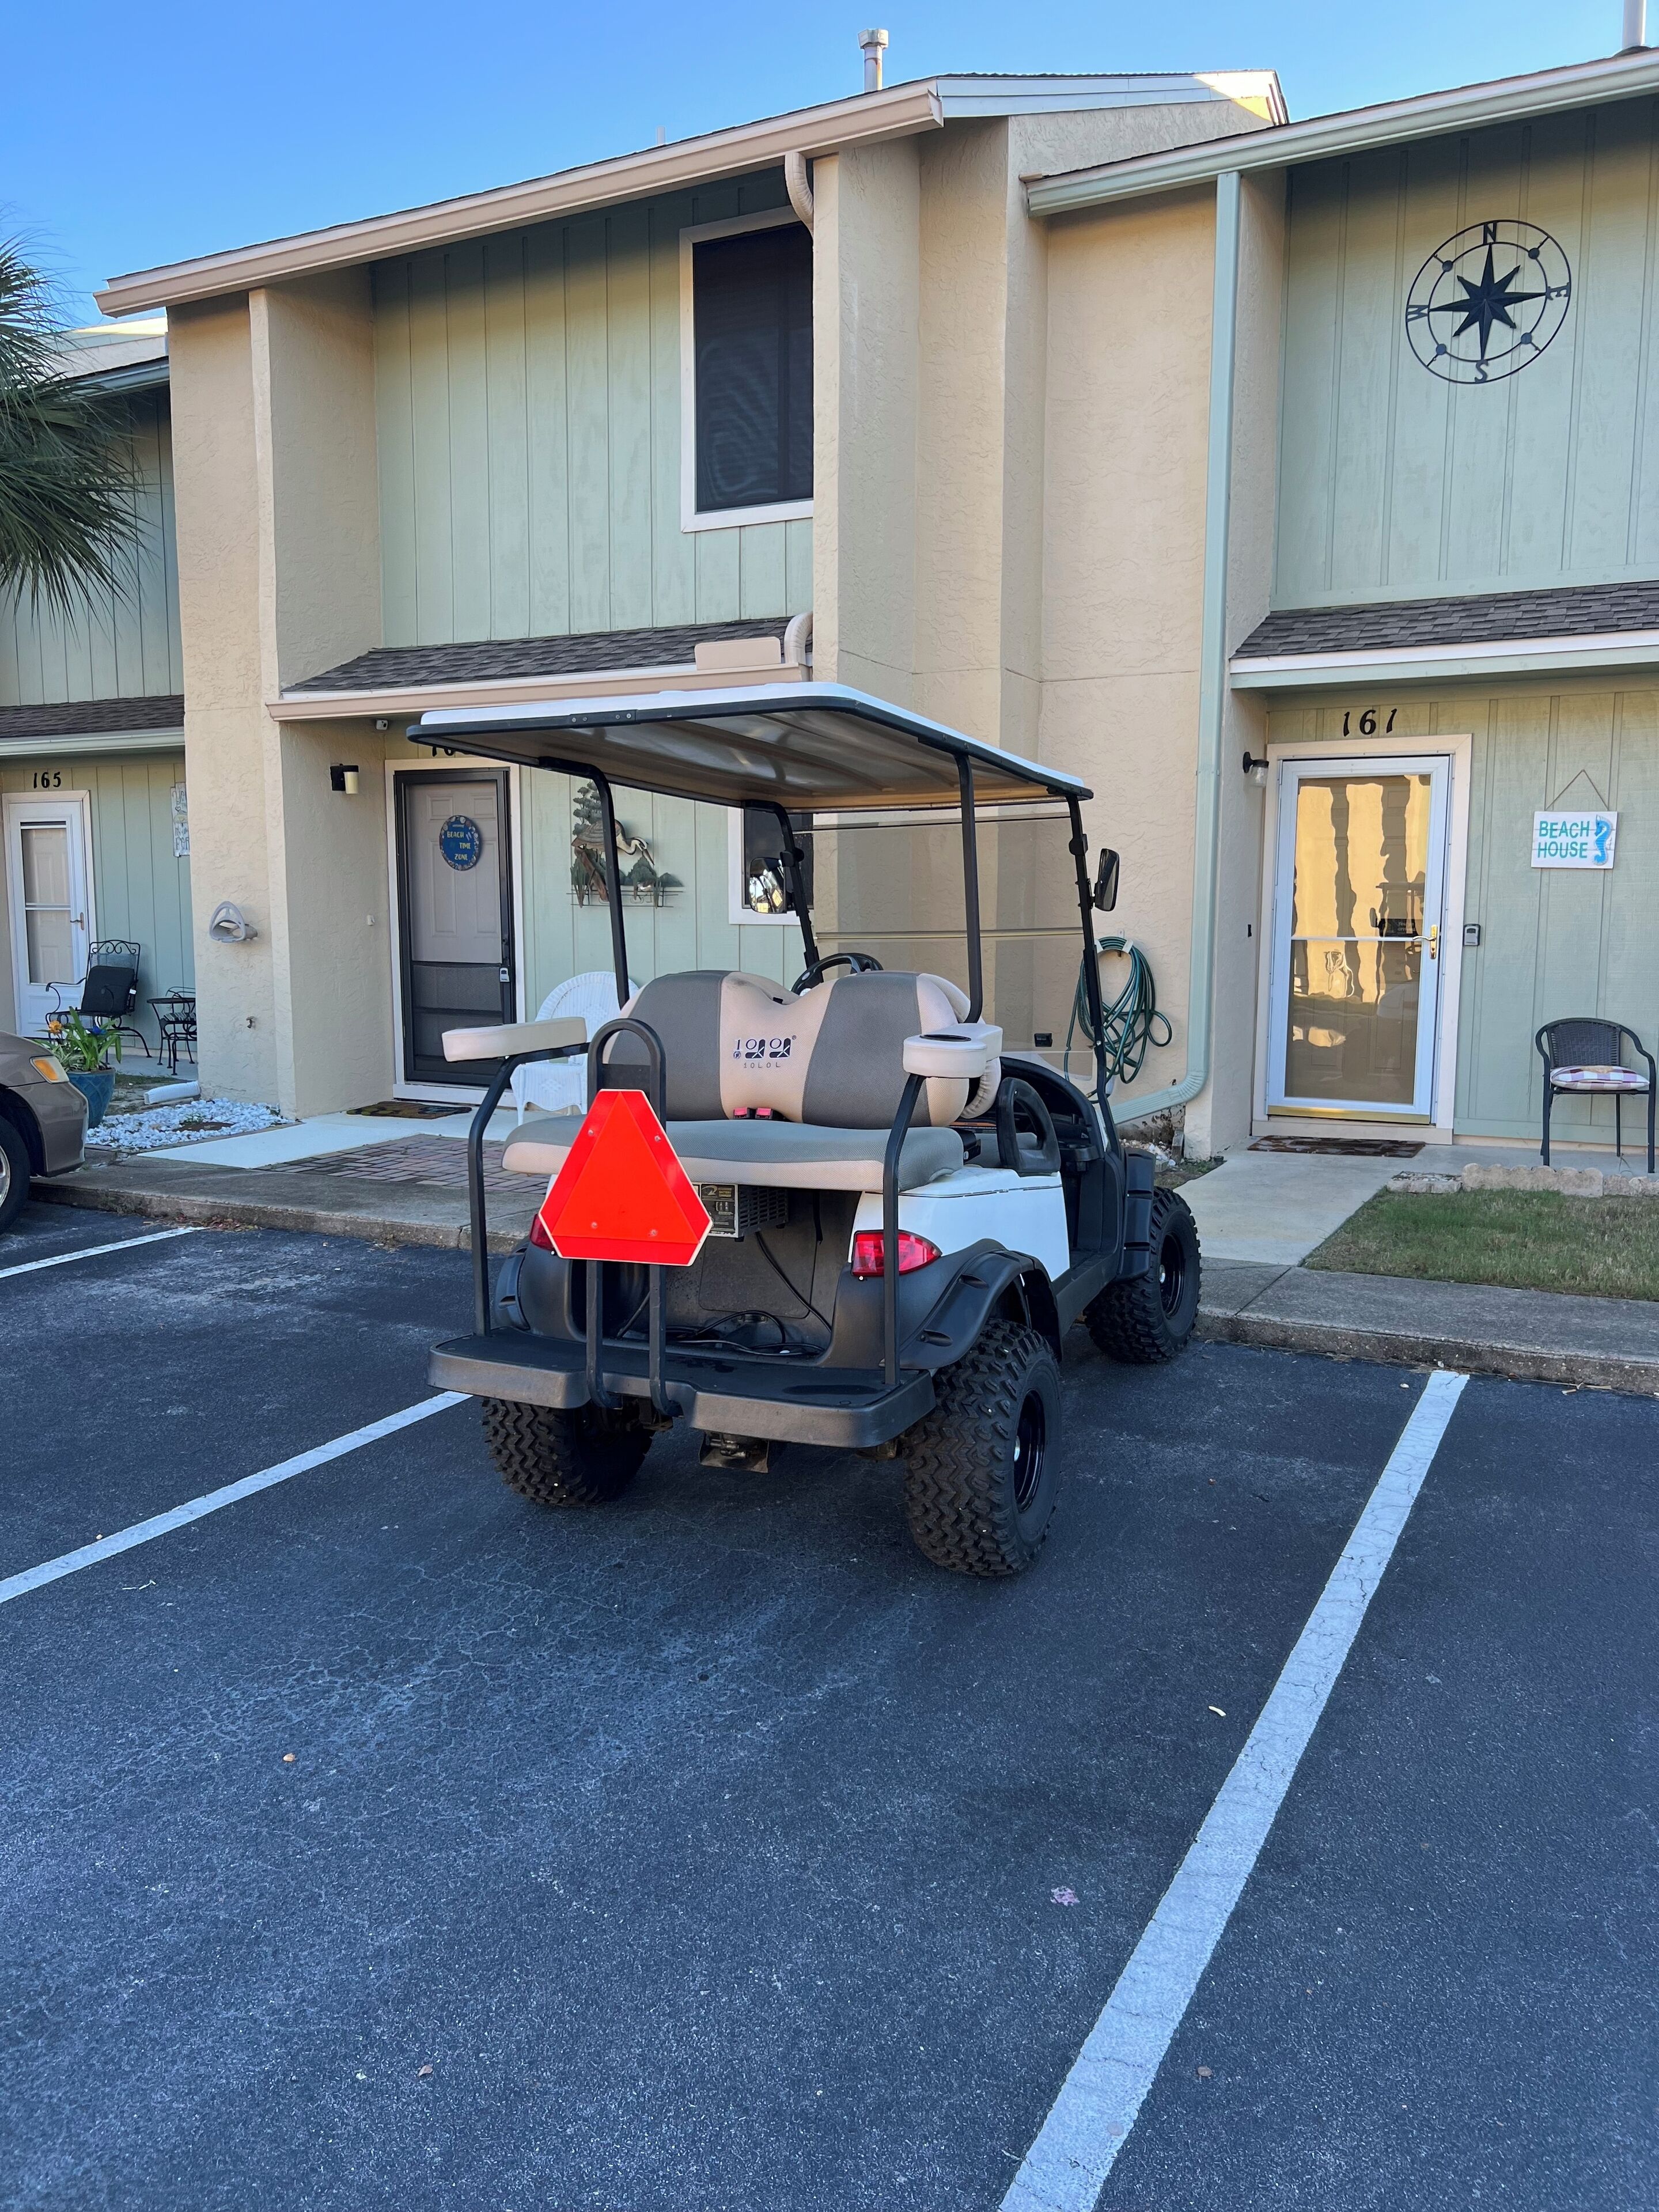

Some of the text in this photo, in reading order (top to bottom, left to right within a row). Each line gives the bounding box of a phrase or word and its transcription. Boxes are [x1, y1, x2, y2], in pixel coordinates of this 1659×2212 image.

[1483, 221, 1497, 245] N
[1546, 282, 1571, 300] E
[1474, 359, 1489, 383] S
[1343, 708, 1397, 737] 161
[33, 771, 61, 789] 165
[1539, 820, 1590, 839] BEACH
[1537, 841, 1589, 859] HOUSE
